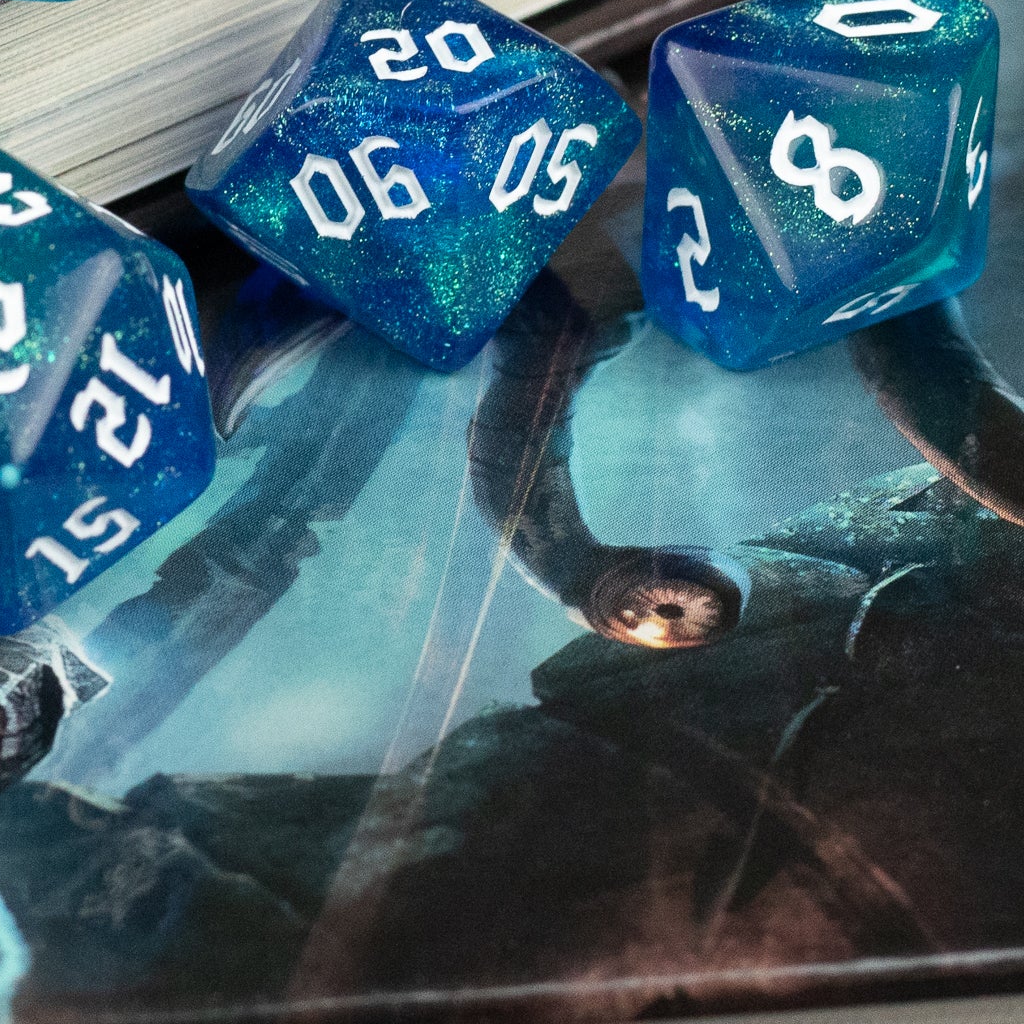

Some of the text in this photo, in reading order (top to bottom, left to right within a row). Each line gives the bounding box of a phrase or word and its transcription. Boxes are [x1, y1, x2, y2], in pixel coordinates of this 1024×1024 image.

[361, 21, 495, 81] 20
[770, 110, 880, 225] 8
[668, 189, 719, 311] 2
[70, 333, 171, 468] 12
[26, 497, 139, 583] 15
